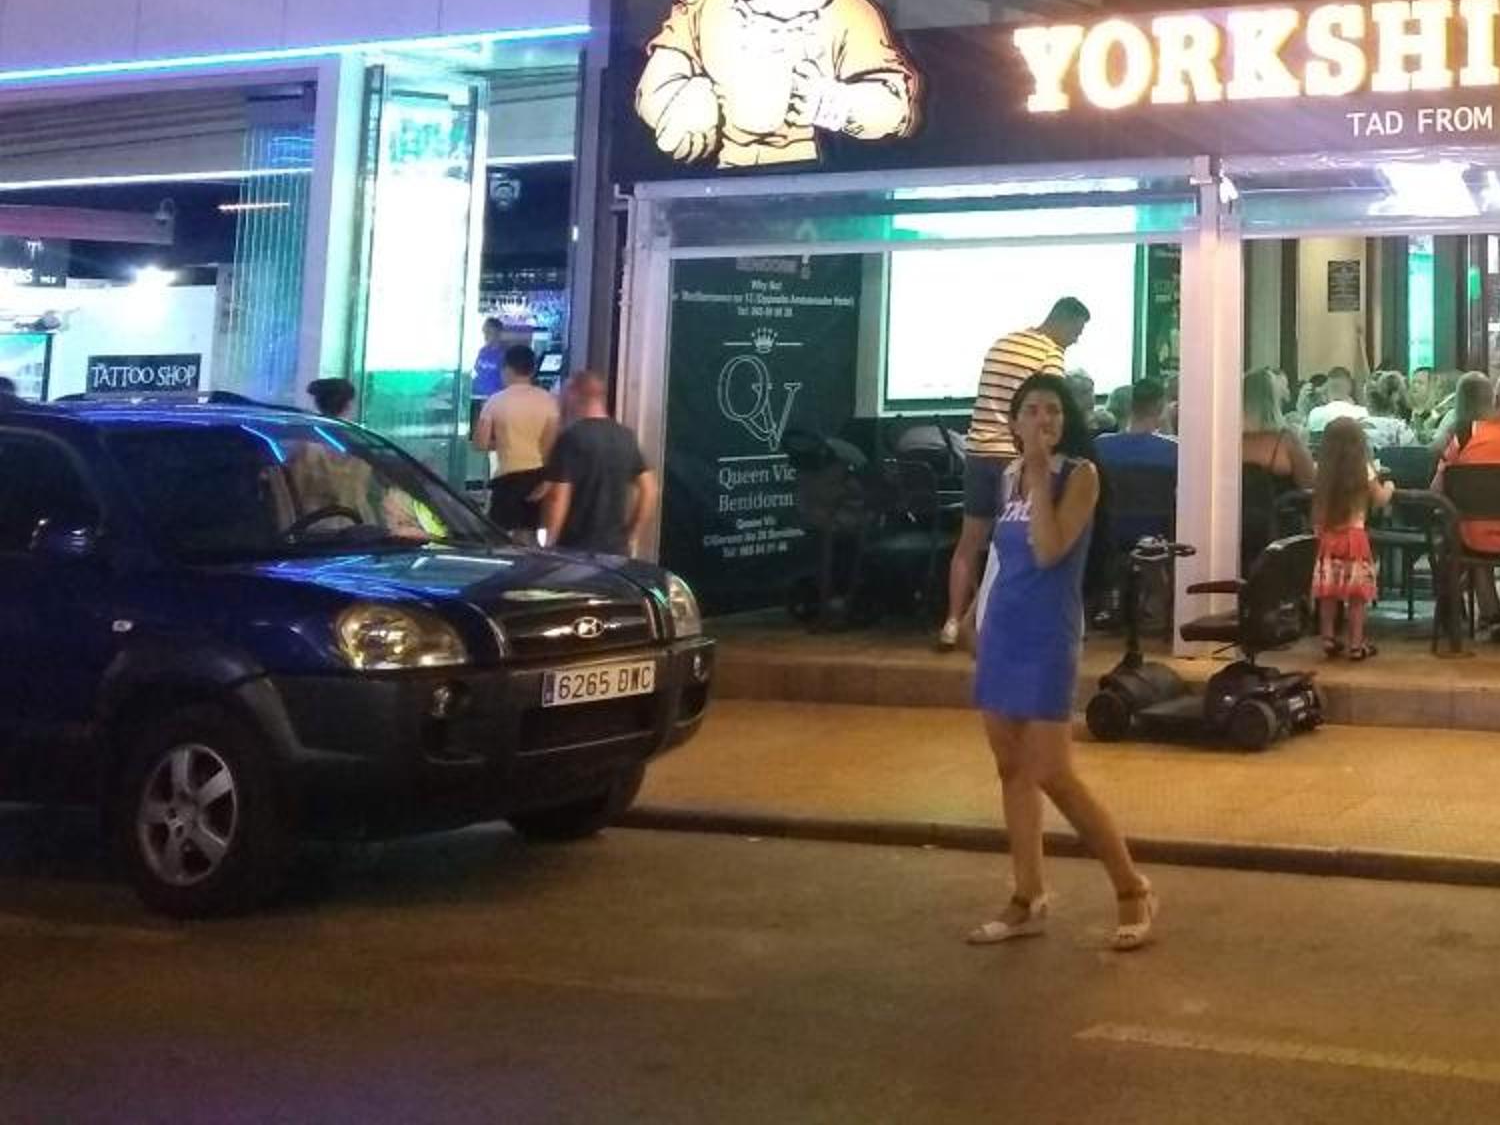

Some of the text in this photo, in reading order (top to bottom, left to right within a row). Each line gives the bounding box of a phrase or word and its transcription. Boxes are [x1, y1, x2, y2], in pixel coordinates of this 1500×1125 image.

[1346, 110, 1403, 137] TAD
[1417, 106, 1493, 133] FROM
[91, 363, 197, 388] TATTOO SHOP
[719, 467, 769, 490] Queen
[559, 670, 609, 699] 6265
